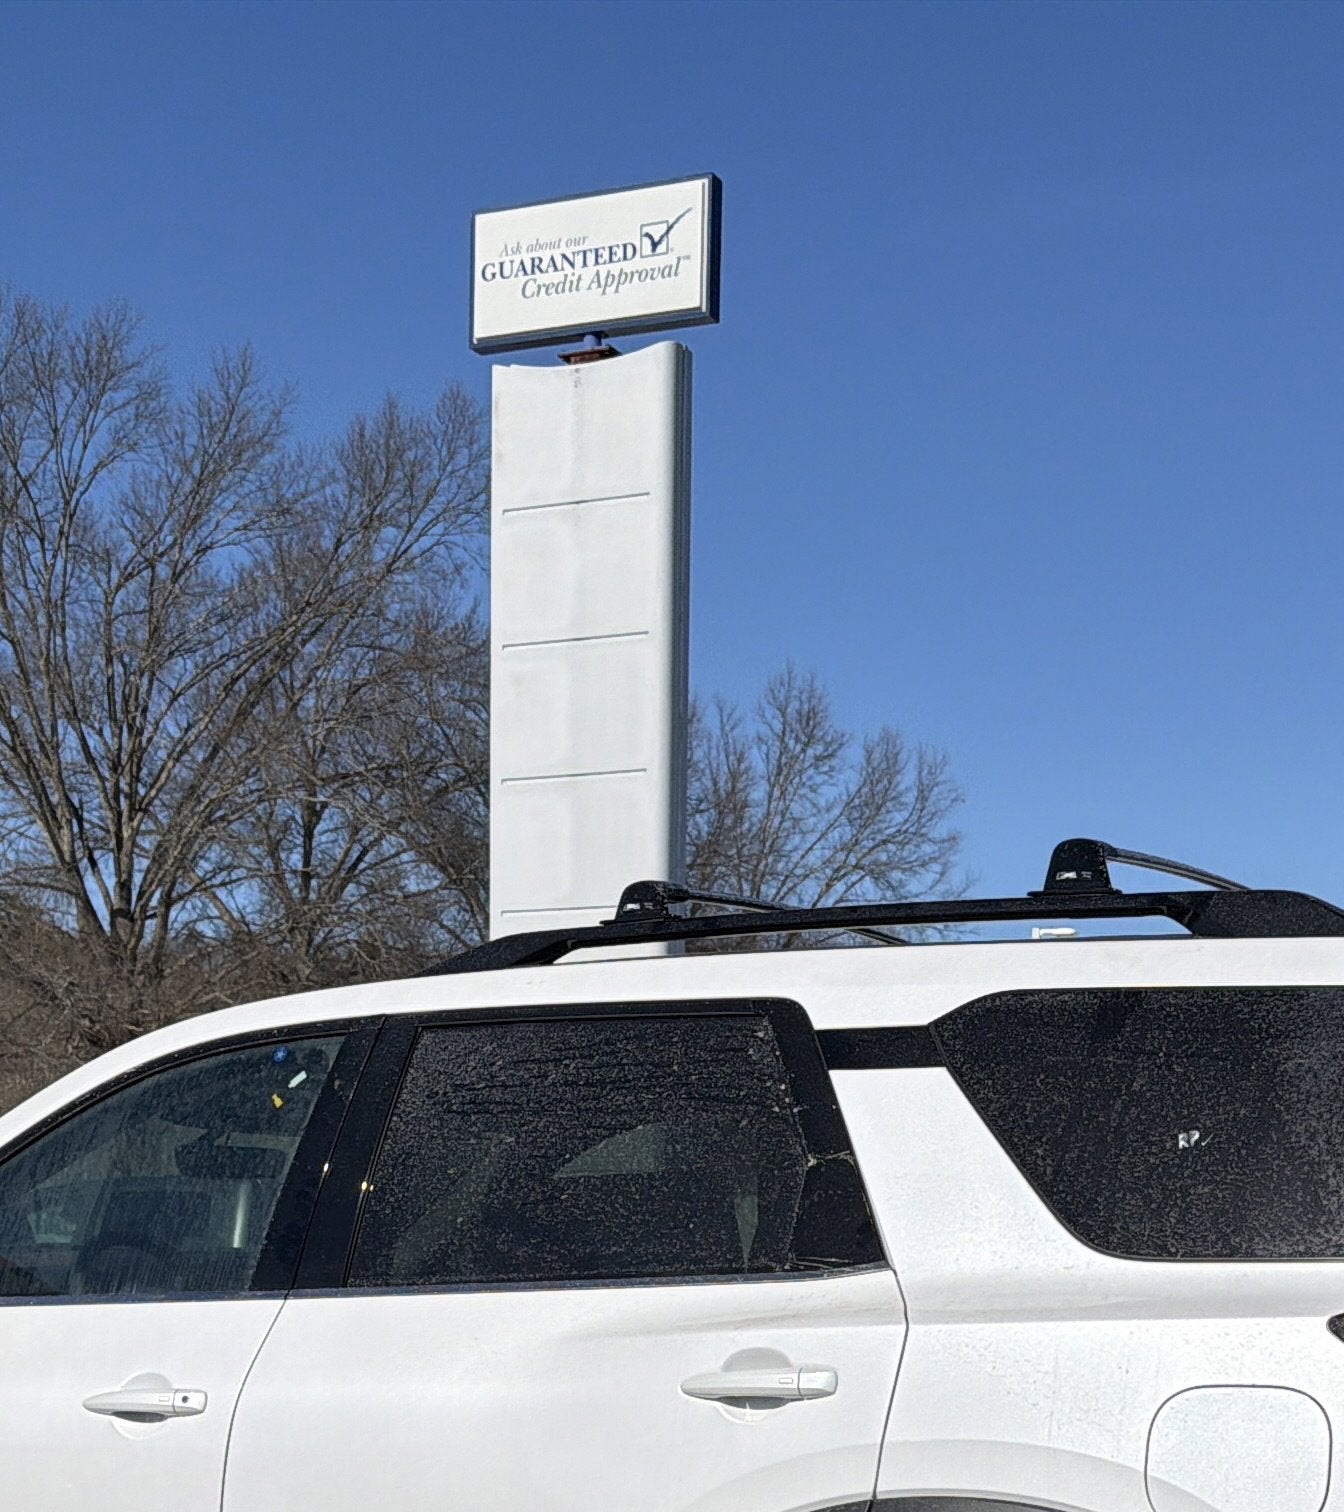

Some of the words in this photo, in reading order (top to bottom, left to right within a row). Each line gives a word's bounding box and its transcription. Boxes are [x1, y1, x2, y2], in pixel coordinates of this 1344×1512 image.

[481, 241, 637, 283] GUARANTEED
[499, 242, 523, 258] Ask
[526, 237, 562, 254] about
[565, 235, 589, 248] our
[521, 272, 583, 299] Credit
[586, 256, 681, 296] Approval
